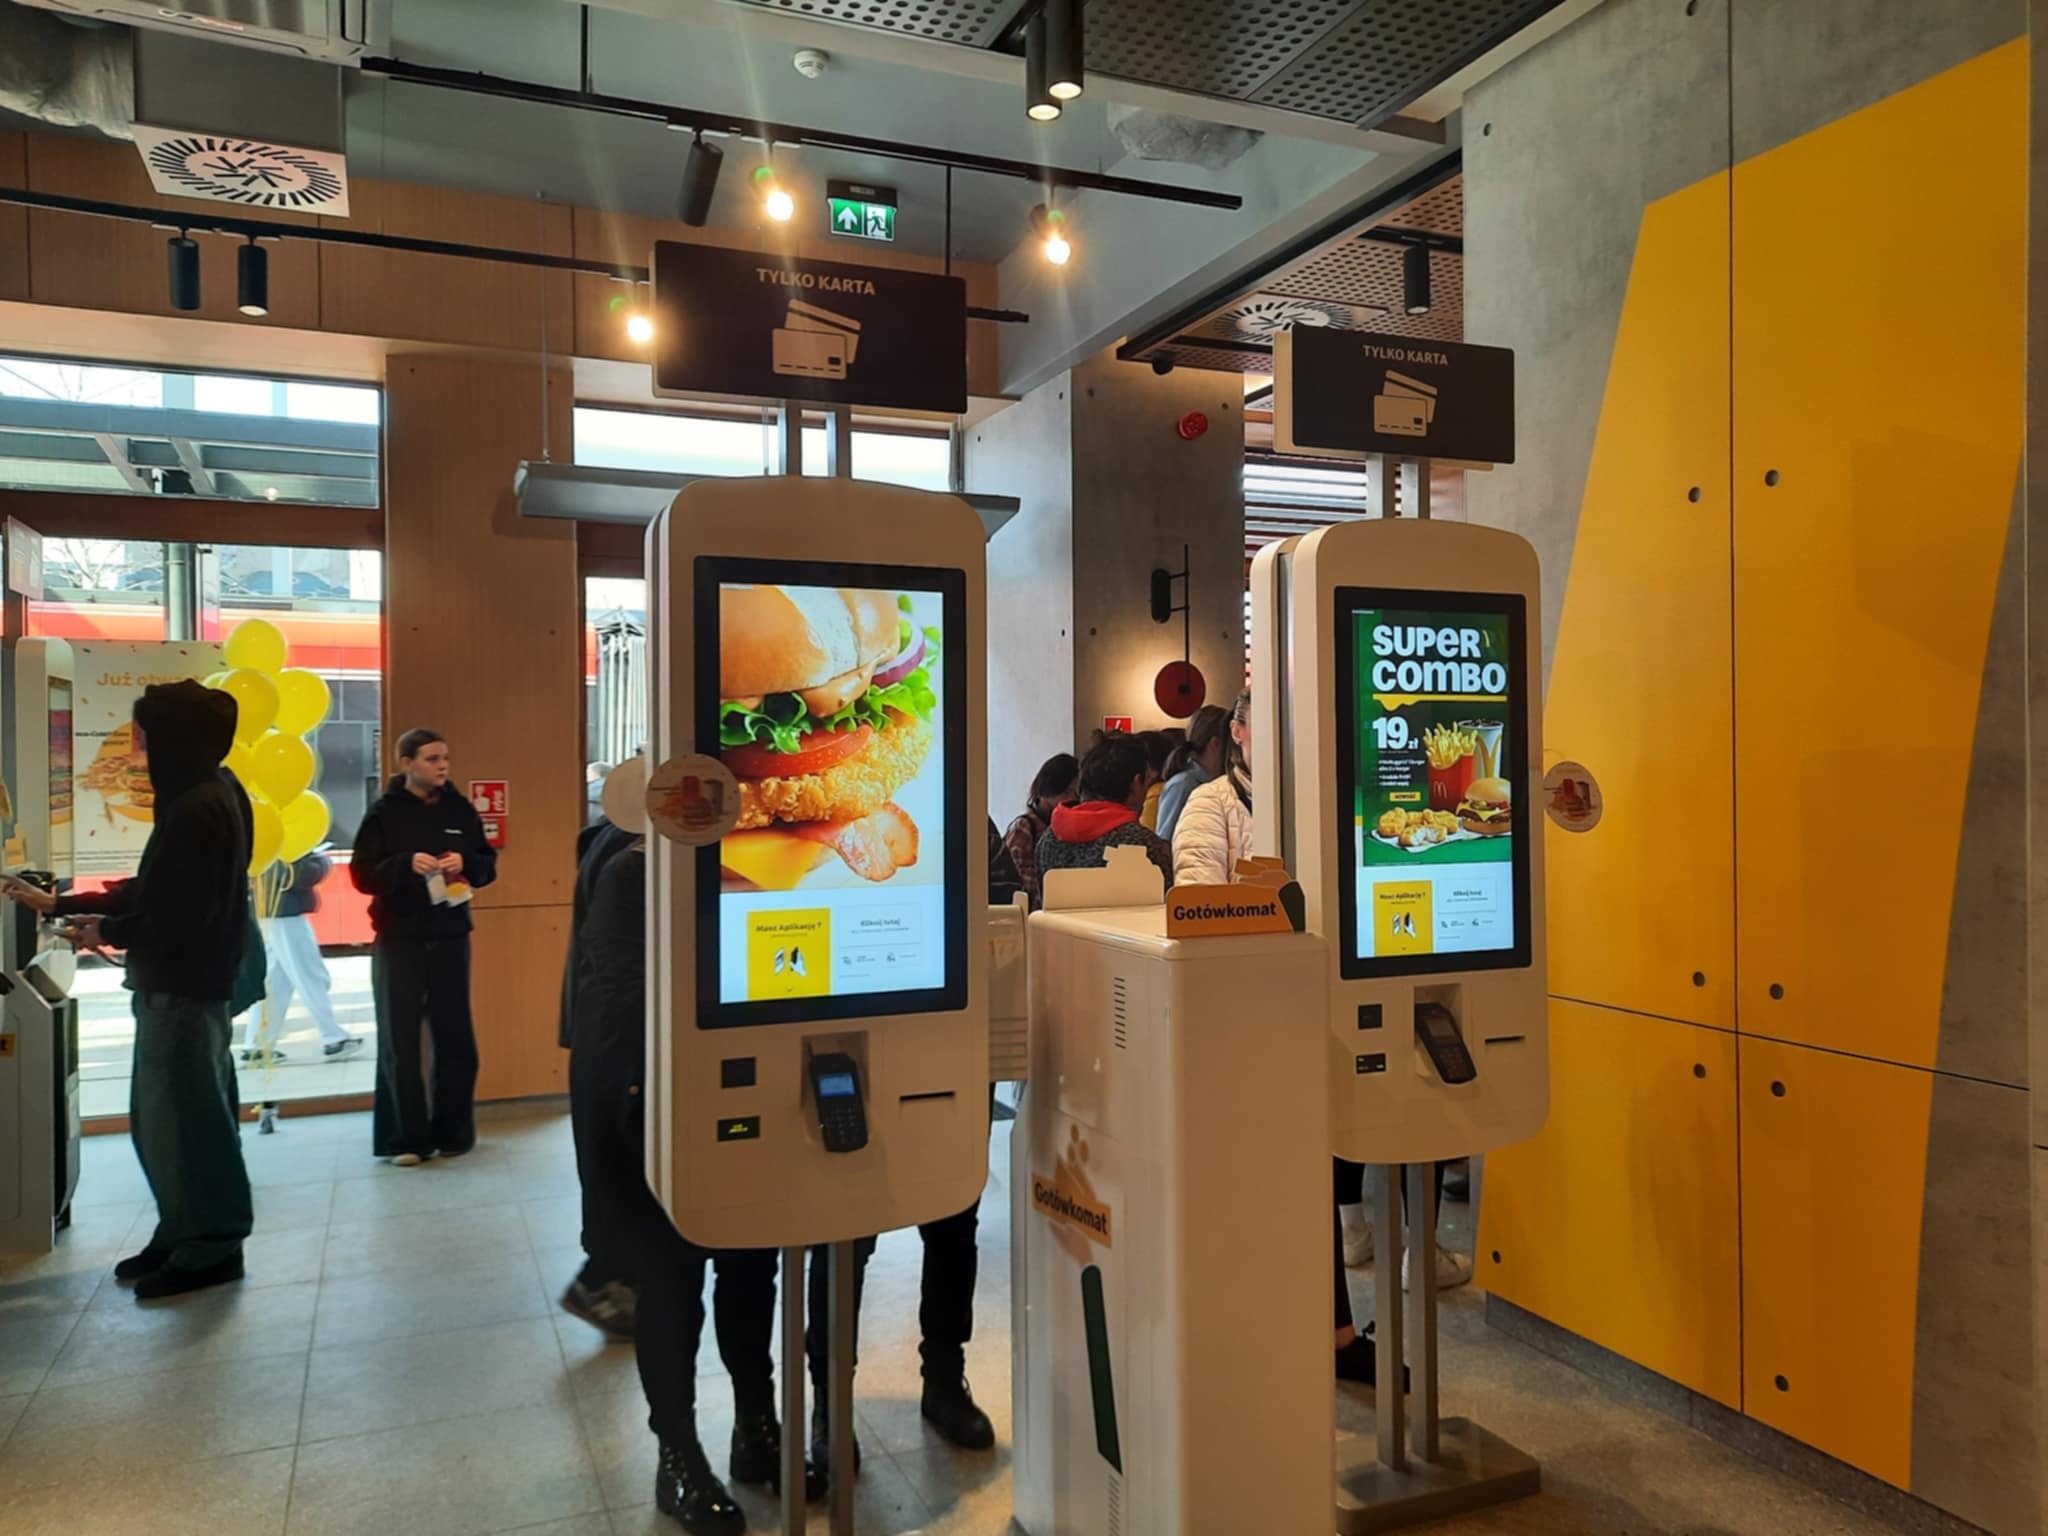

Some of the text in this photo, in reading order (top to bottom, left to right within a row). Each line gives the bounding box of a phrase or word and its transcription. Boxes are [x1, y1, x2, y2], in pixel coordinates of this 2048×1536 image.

[756, 267, 815, 288] TYLKO
[1362, 344, 1404, 361] TYLKO
[96, 672, 133, 687] Już
[1372, 716, 1408, 750] 19
[1173, 902, 1277, 921] Gotówkomat
[1034, 1182, 1107, 1235] Gotówkomat
